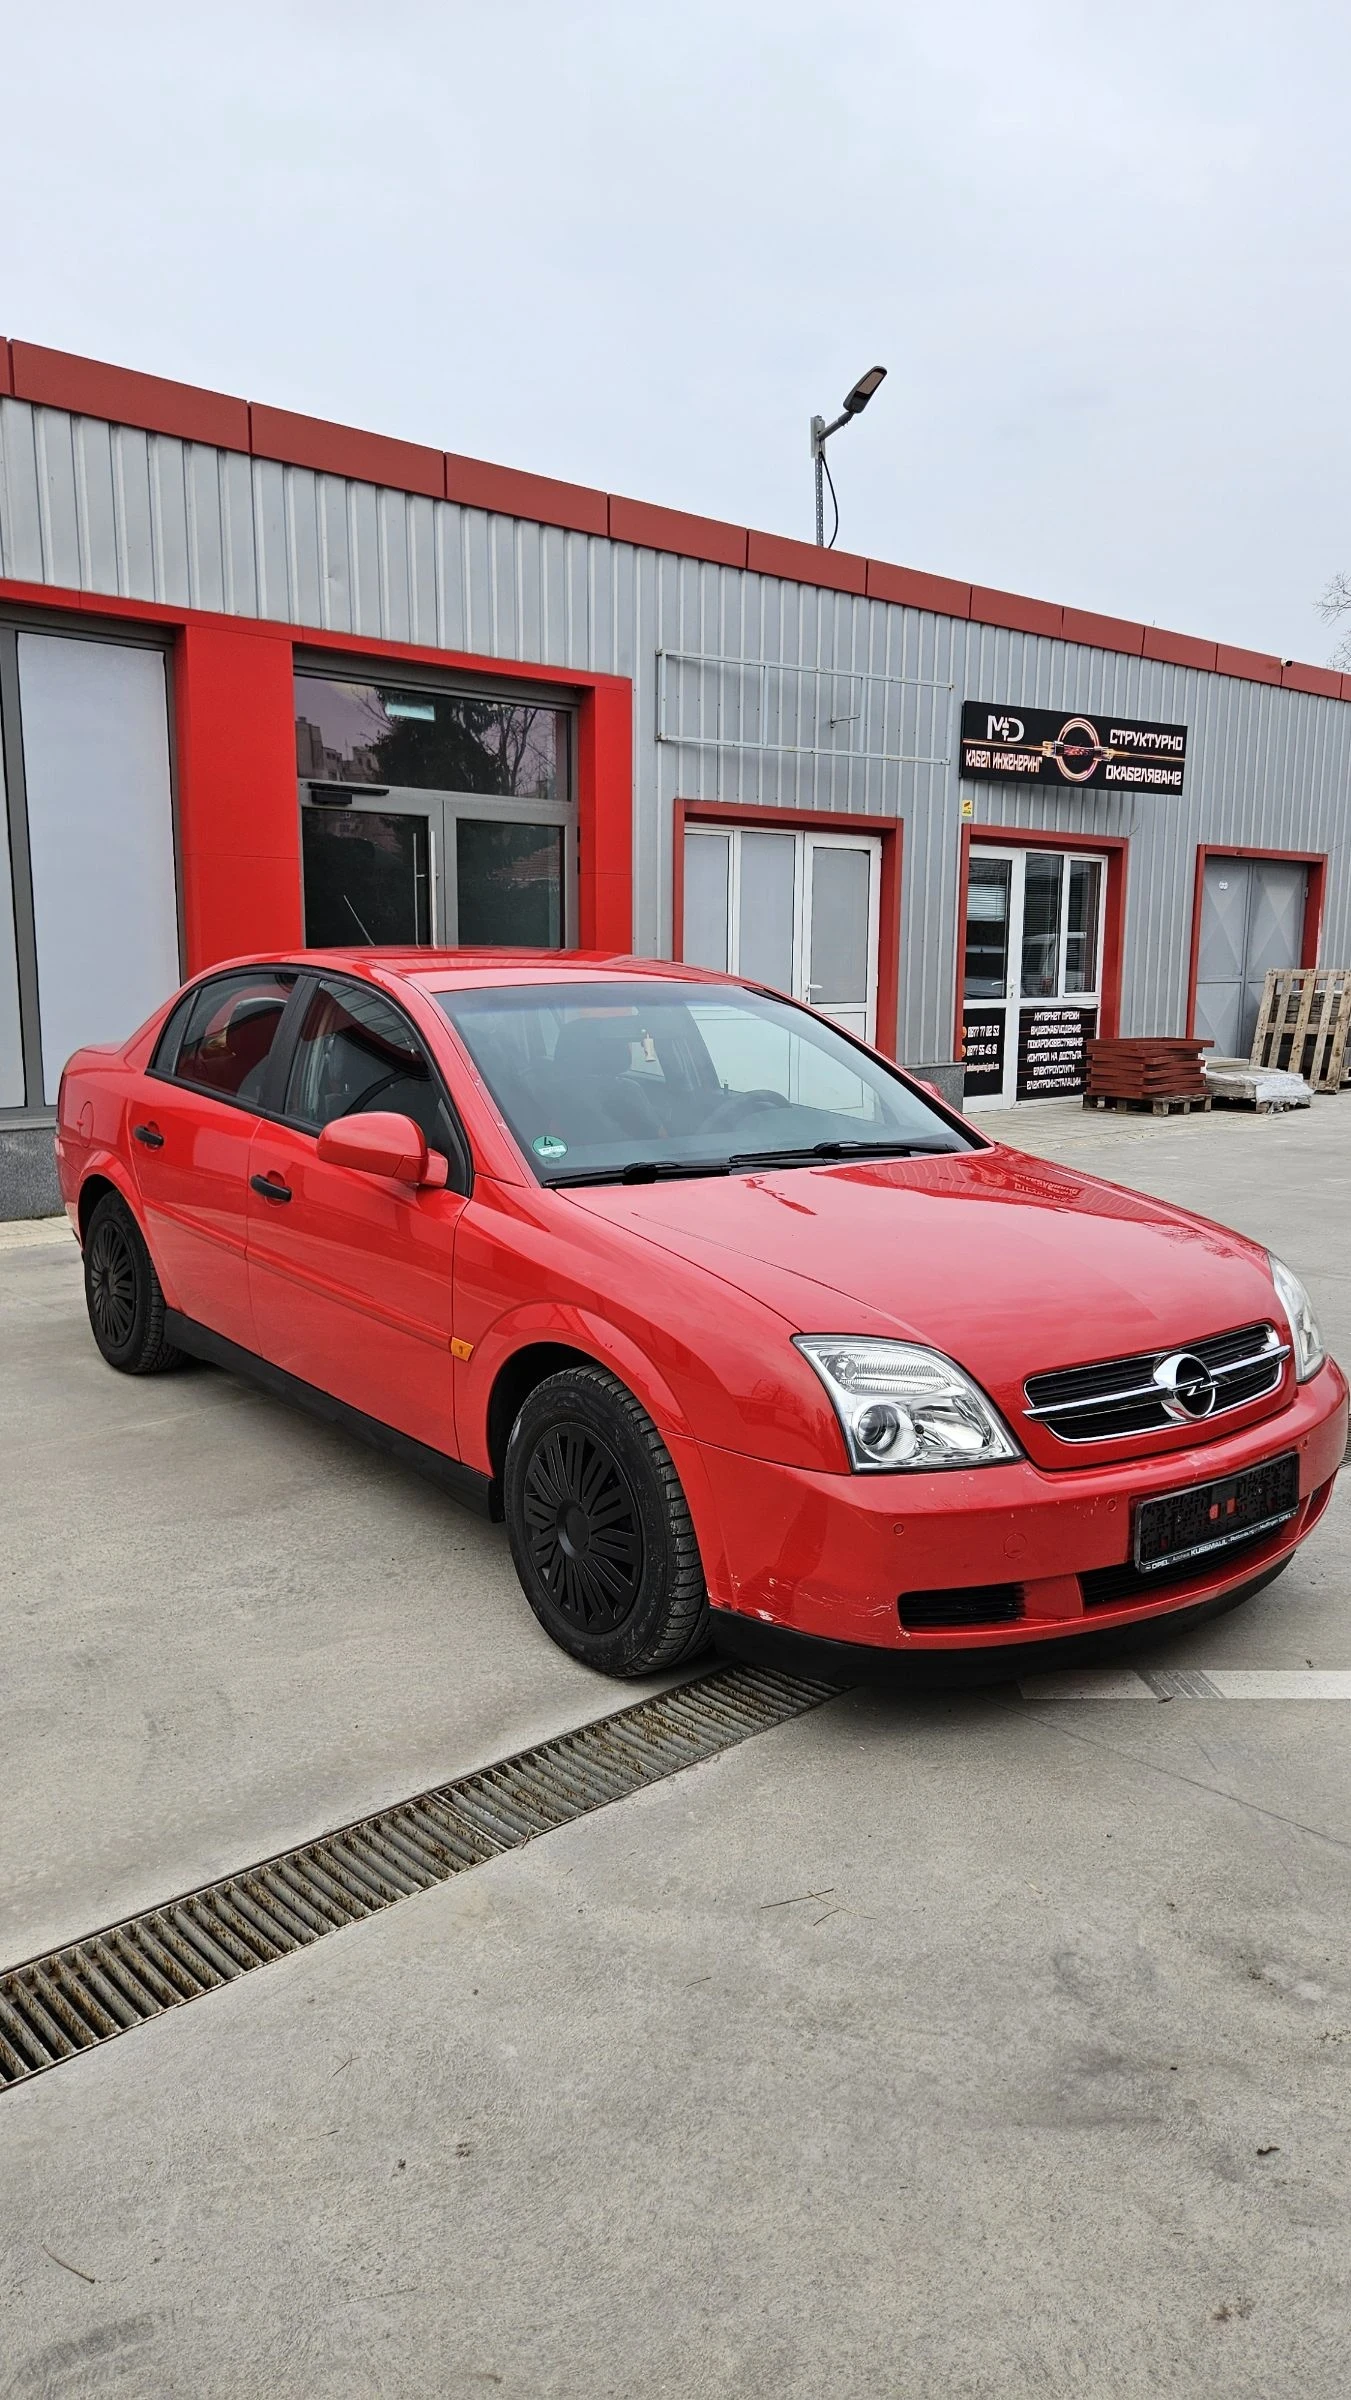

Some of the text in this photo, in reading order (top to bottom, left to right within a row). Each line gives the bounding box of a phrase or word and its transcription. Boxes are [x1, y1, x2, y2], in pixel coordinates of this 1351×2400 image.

[1110, 729, 1184, 751] СТРУКТУРНО
[965, 749, 1043, 773] КАБЕЛ ИНЖЕНЕРИНГ
[1105, 764, 1182, 786] ОКАБЕЛЯВАНЕ
[1034, 1011, 1080, 1021] ИНТЕРНЕТ МРЕЖИ
[1027, 1052, 1050, 1063] КОНТРОЛ
[1051, 1051, 1058, 1061] НА
[544, 1137, 553, 1146] 4
[1152, 1559, 1169, 1569] OPEL
[1191, 1539, 1227, 1555] KUSSMAUL
